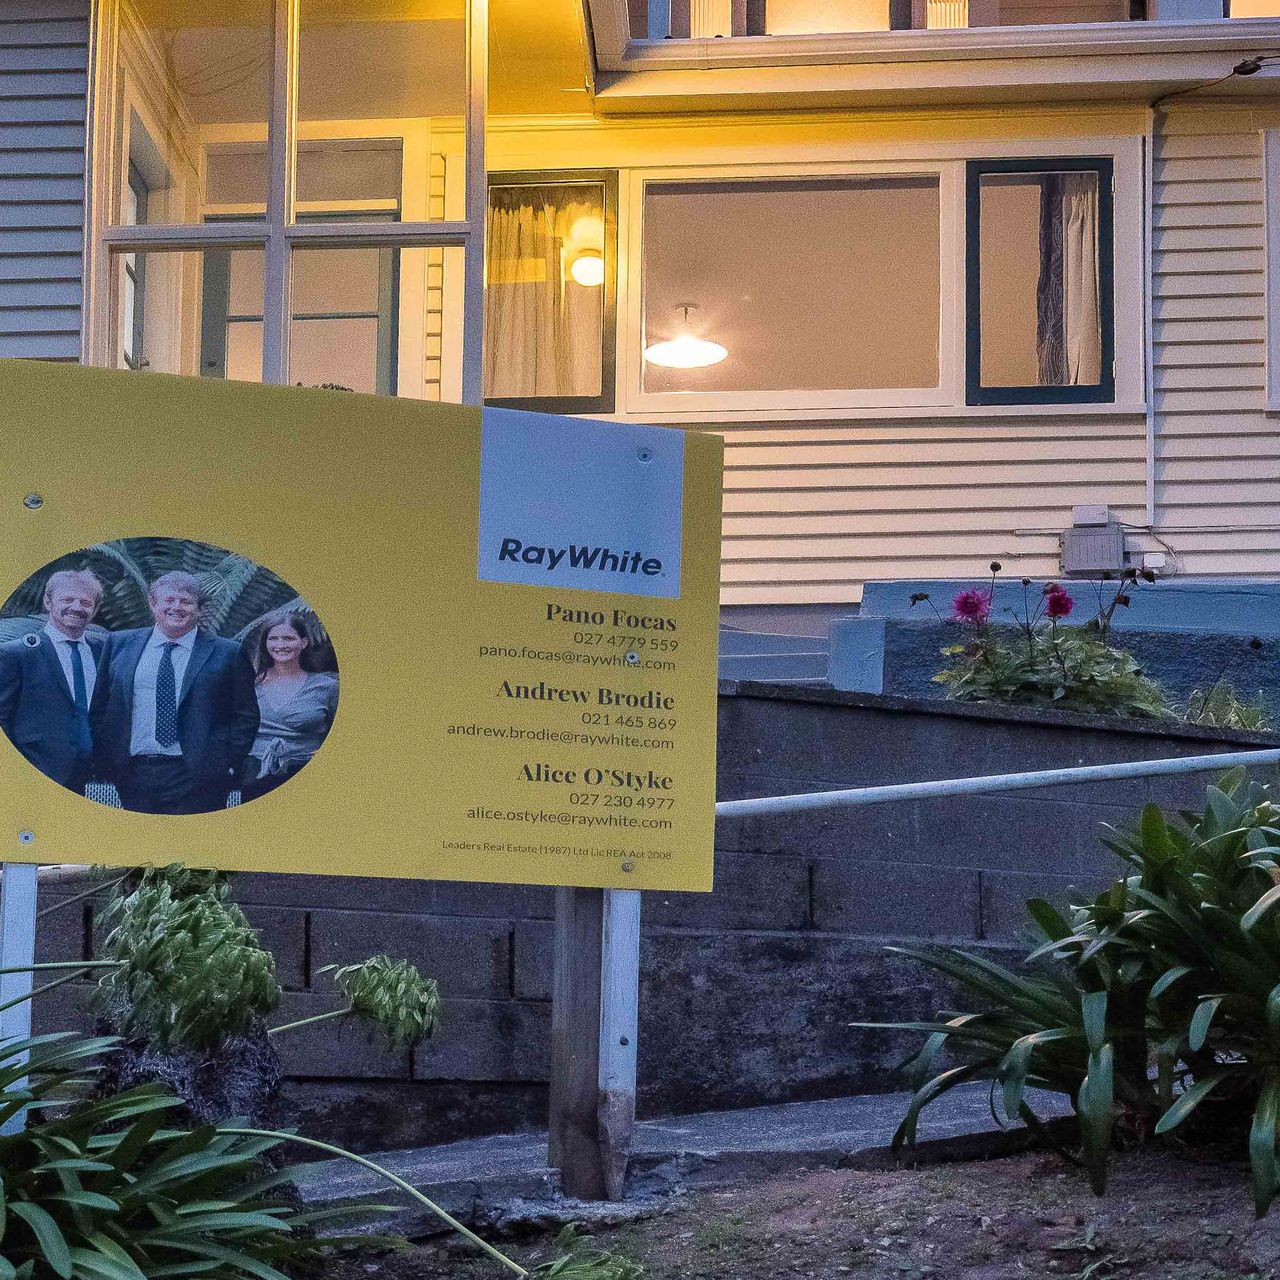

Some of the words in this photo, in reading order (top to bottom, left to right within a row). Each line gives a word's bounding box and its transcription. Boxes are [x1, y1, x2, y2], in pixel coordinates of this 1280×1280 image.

[498, 538, 666, 577] RayWhite
[546, 603, 605, 626] Pano
[612, 609, 677, 632] Focas
[573, 632, 603, 646] 027
[607, 634, 646, 649] 4779
[650, 639, 679, 652] 559
[496, 680, 590, 704] Andrew
[597, 687, 676, 710] Brodie
[581, 712, 610, 726] 021
[614, 715, 644, 728] 465
[648, 718, 677, 731] 869
[447, 723, 674, 749] andrew.brodie@raywhite.com
[516, 763, 577, 783] Alice
[583, 767, 674, 792] O'Styke
[569, 792, 599, 806] 027
[603, 794, 633, 808] 230
[636, 796, 675, 810] 4977
[467, 807, 672, 830] alice.ostyke@raywhite.com
[442, 840, 481, 851] Leaders
[483, 842, 506, 852] Real
[506, 843, 538, 854] Estate
[539, 844, 571, 857] (1987)
[573, 847, 589, 857] Ltd
[606, 849, 627, 858] REA
[629, 850, 645, 860] Act
[647, 851, 672, 861] 2008
